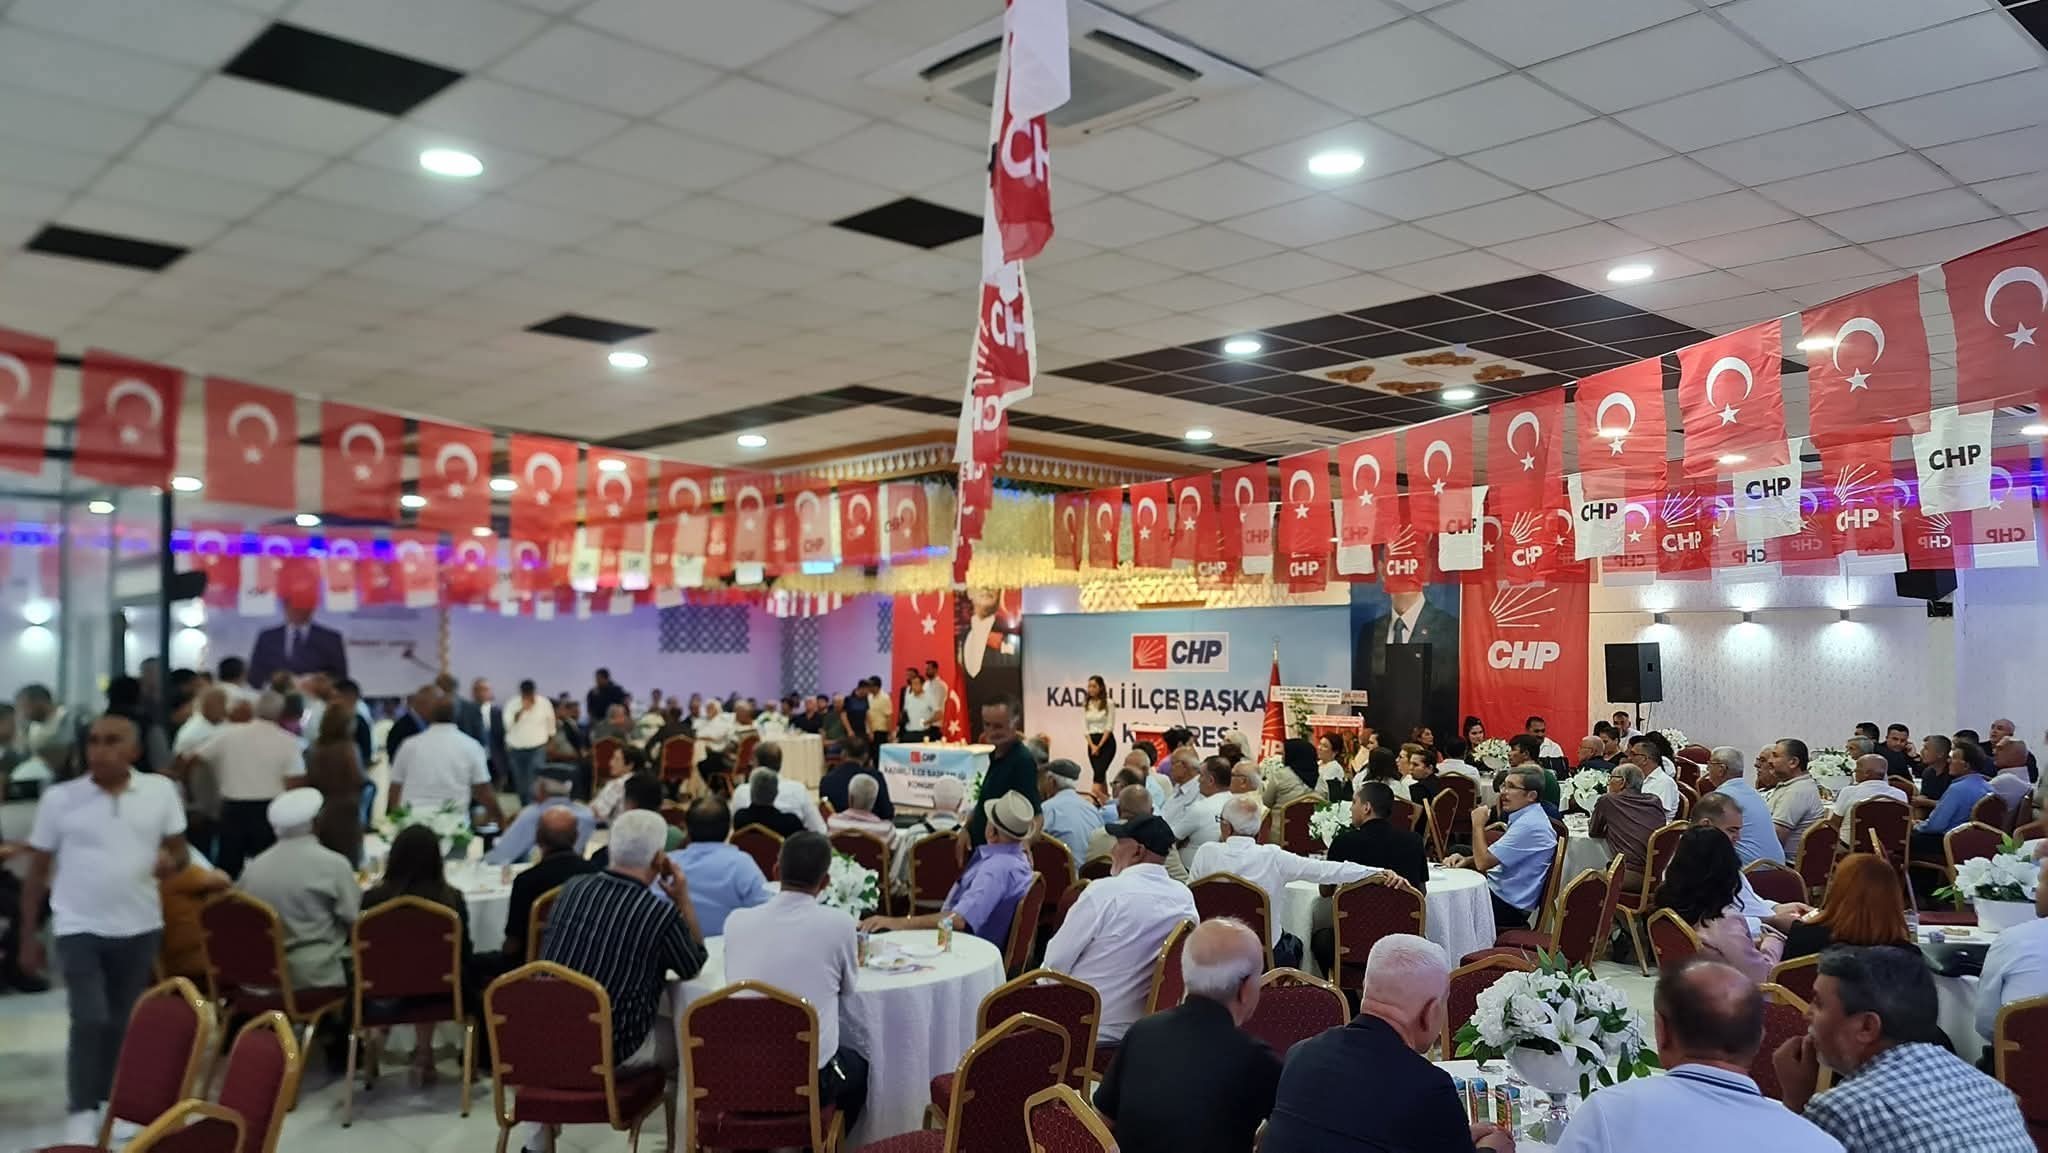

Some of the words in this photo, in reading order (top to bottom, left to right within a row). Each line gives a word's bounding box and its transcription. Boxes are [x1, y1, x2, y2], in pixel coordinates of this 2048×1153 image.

[1002, 119, 1050, 182] CH
[991, 300, 1027, 351] CH
[1929, 444, 1981, 470] CHP
[1746, 477, 1791, 499] CHP
[1581, 502, 1618, 521] CHP
[1836, 508, 1880, 532] CHP
[1446, 518, 1477, 535] CHP
[1662, 531, 1702, 552] CHP
[1387, 558, 1418, 575] CHP
[1512, 545, 1543, 567] CHP
[1198, 560, 1227, 577] CHP
[1290, 561, 1319, 577] CHP
[1171, 640, 1223, 664] CHP
[1488, 640, 1560, 669] CHP
[1047, 682, 1125, 708] KADLİ
[1132, 682, 1178, 714] İLÇE
